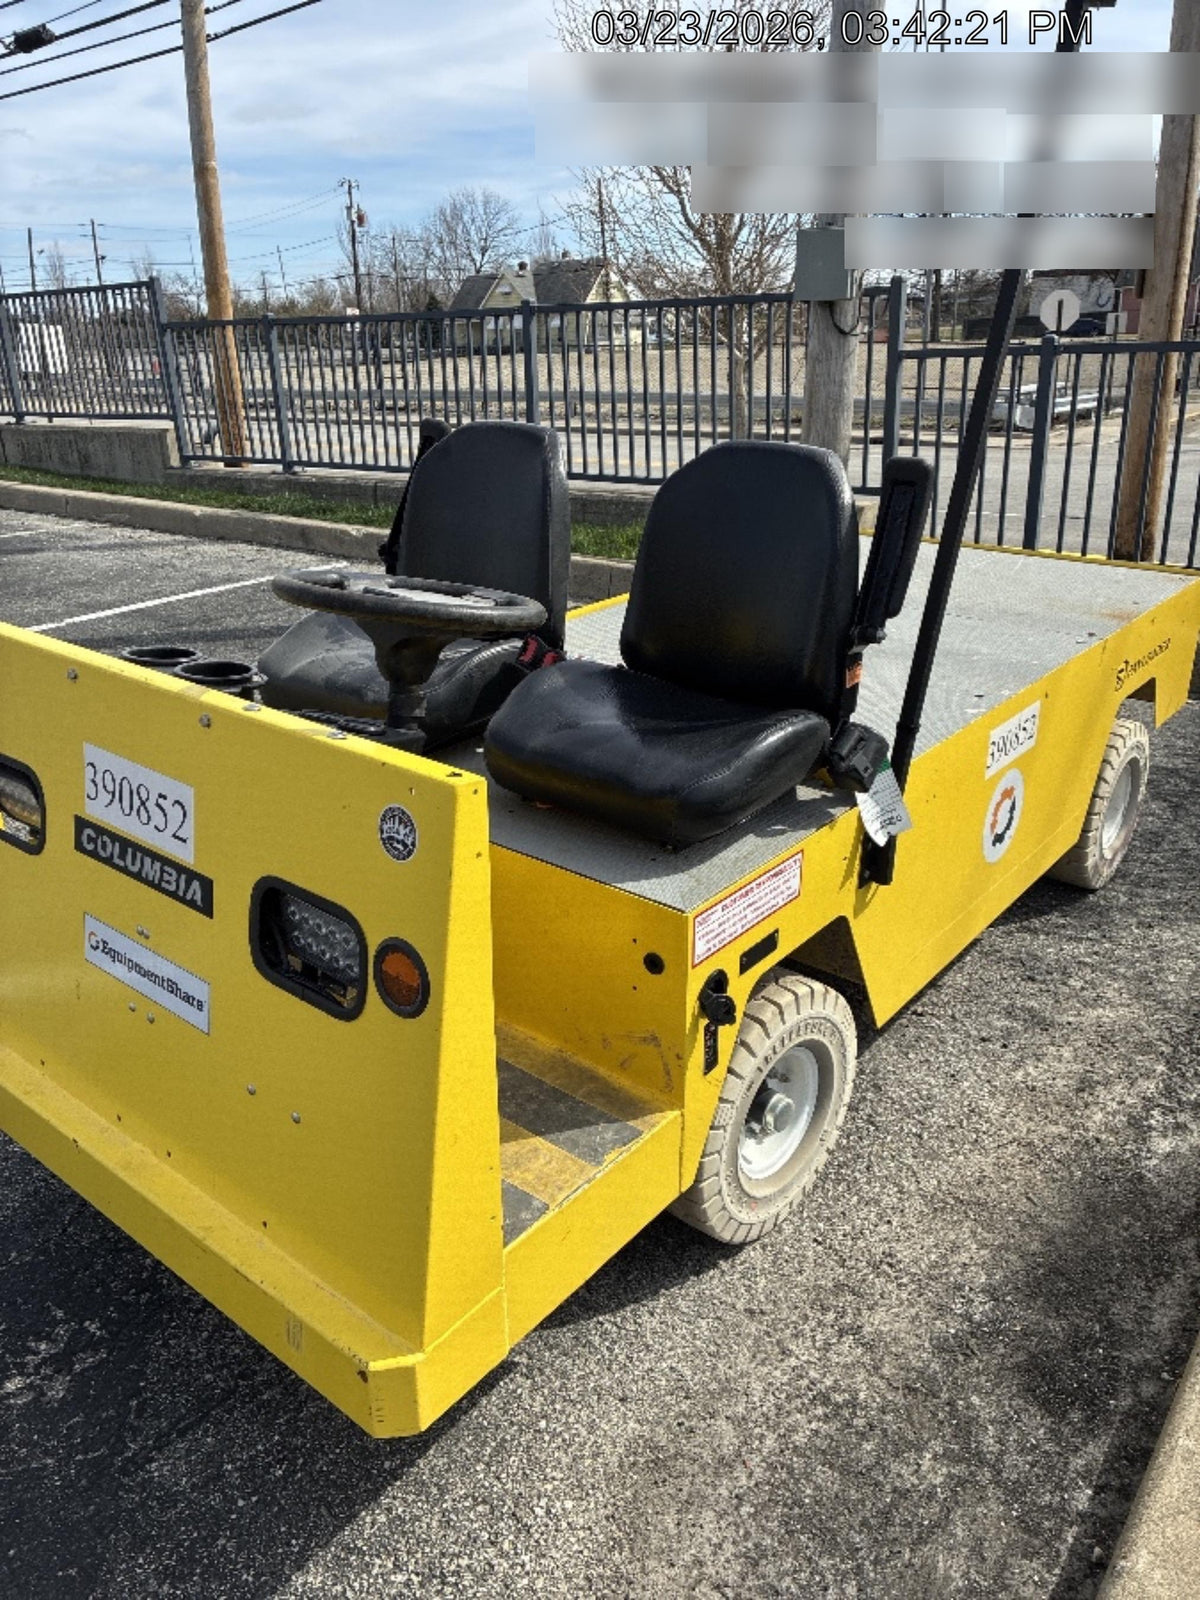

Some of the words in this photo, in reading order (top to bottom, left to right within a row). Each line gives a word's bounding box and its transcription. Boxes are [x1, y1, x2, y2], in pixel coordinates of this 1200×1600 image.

[85, 761, 189, 845] 390852
[80, 827, 204, 908] COLUMBIA
[99, 937, 205, 1012] EquipmentShare
